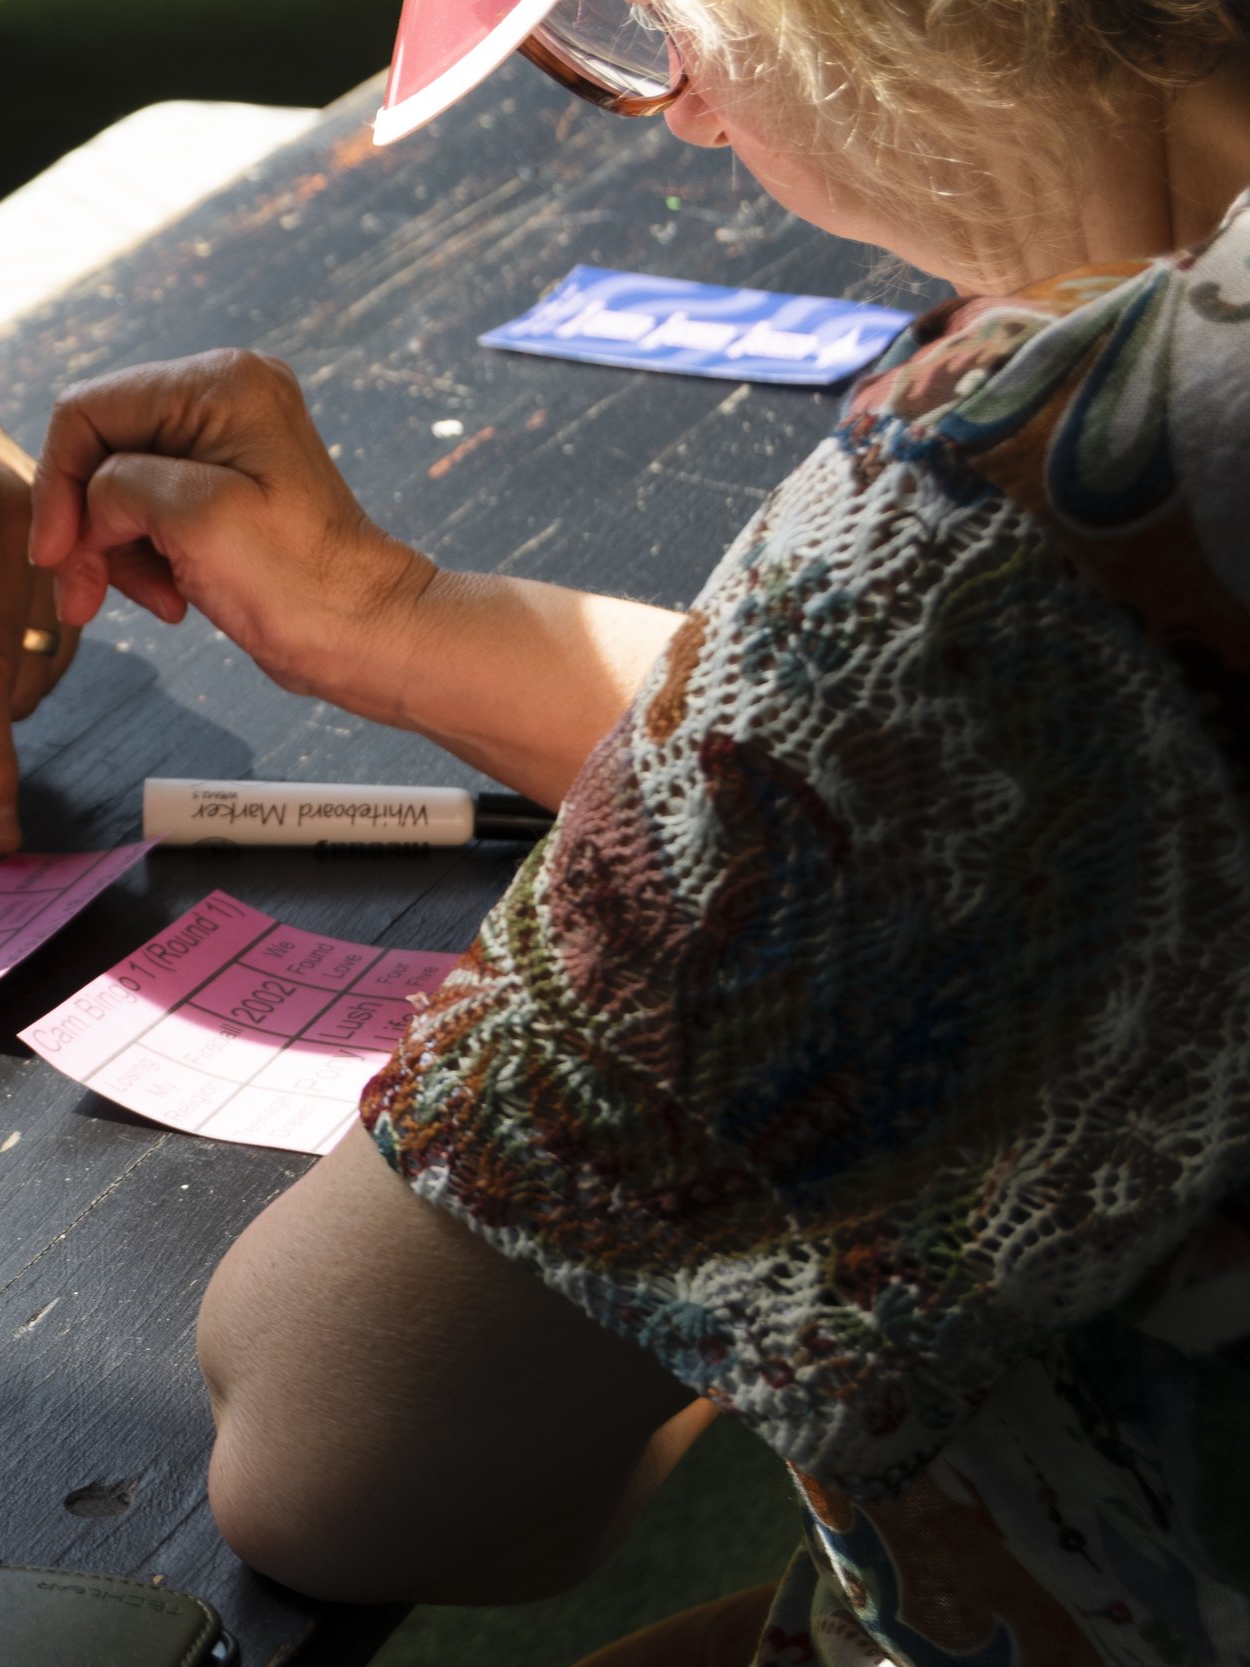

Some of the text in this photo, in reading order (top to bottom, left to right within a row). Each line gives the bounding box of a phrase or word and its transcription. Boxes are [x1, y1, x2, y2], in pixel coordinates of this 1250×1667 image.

[191, 802, 429, 826] Whiteboard Marker
[262, 941, 297, 959] We
[286, 941, 335, 975] Found
[321, 953, 363, 979] Love
[32, 896, 246, 1052] Cam Bingo 1 (Round 1)
[375, 963, 410, 985] Four
[406, 966, 439, 988] Five
[230, 980, 297, 1024] 2002
[318, 1001, 383, 1040] Lush
[183, 1022, 244, 1066] Fireball
[104, 1056, 161, 1094] Losing
[145, 1080, 181, 1098] My
[293, 1049, 366, 1093] Pony
[163, 1079, 226, 1123] Religion
[232, 1094, 293, 1138] Teenage
[269, 1103, 319, 1139] Dream
